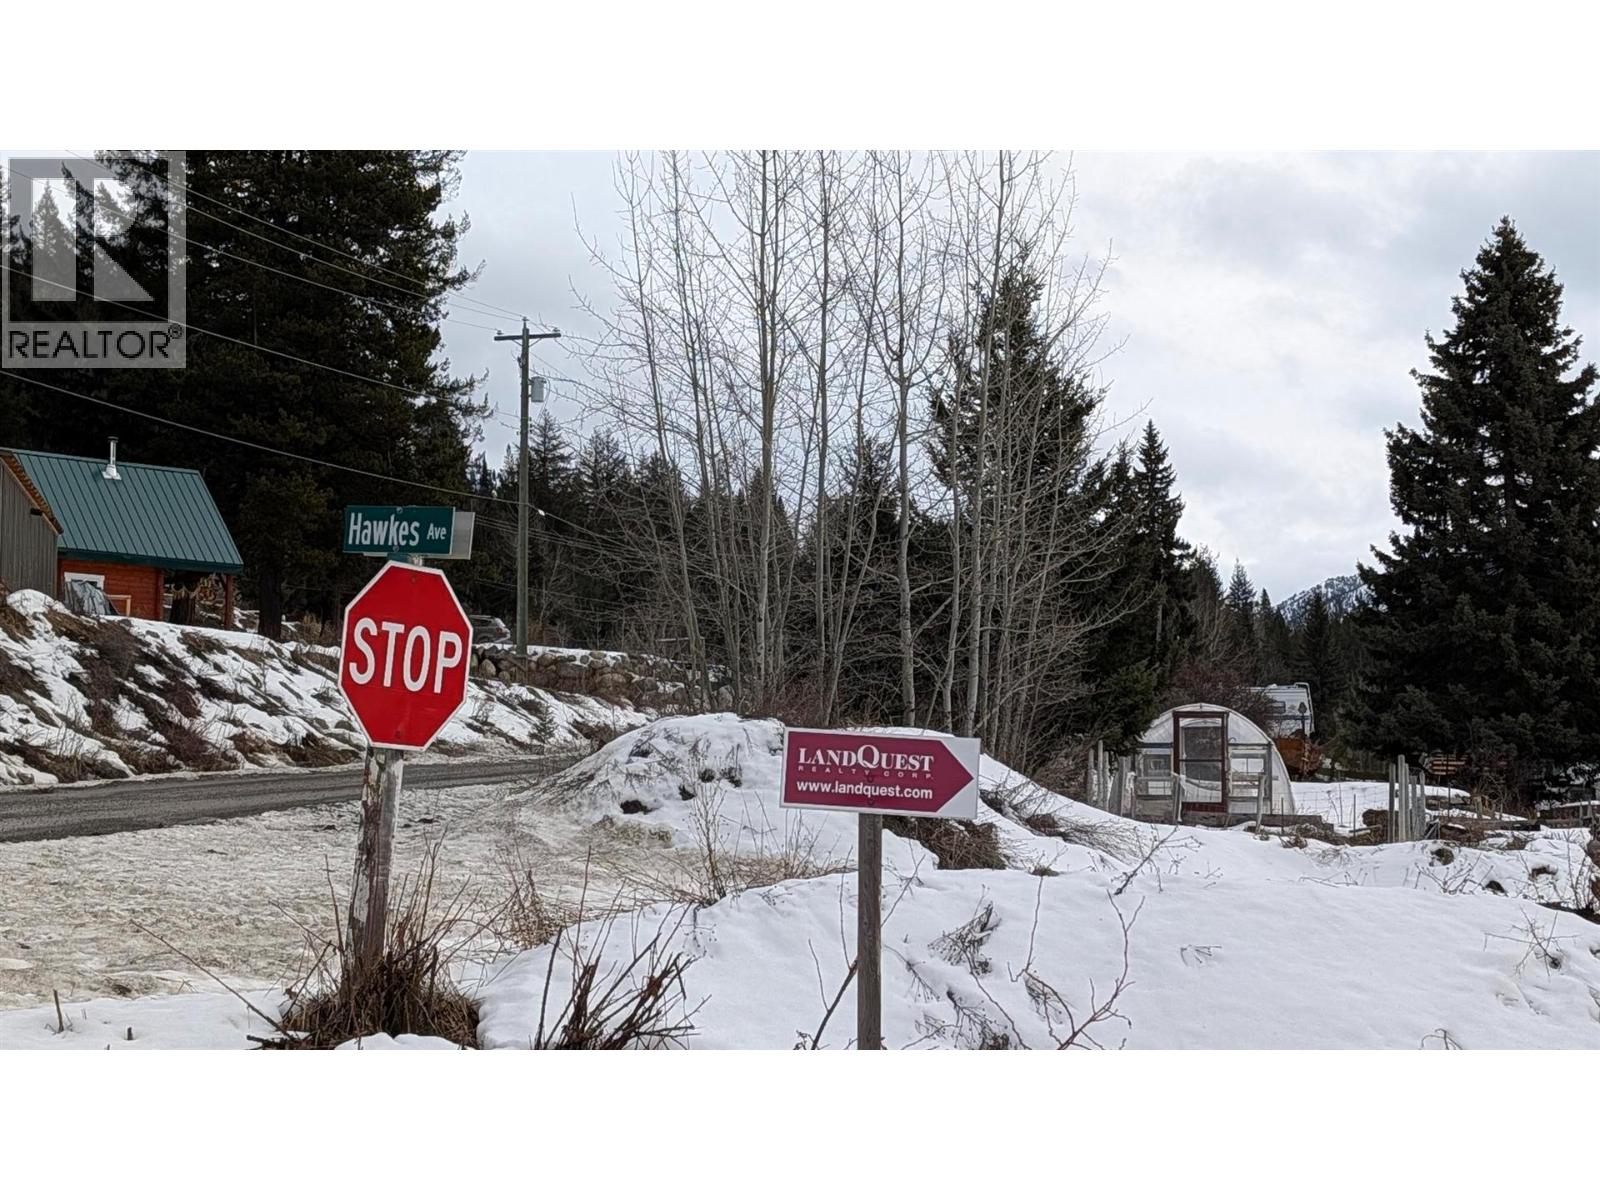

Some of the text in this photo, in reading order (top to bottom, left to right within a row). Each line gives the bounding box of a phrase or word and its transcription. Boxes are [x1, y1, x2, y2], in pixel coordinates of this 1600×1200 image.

[348, 512, 447, 546] Hawkes Ave
[349, 617, 463, 694] STOP
[798, 766, 871, 776] REALTY
[796, 780, 933, 799] www.landquest.com
